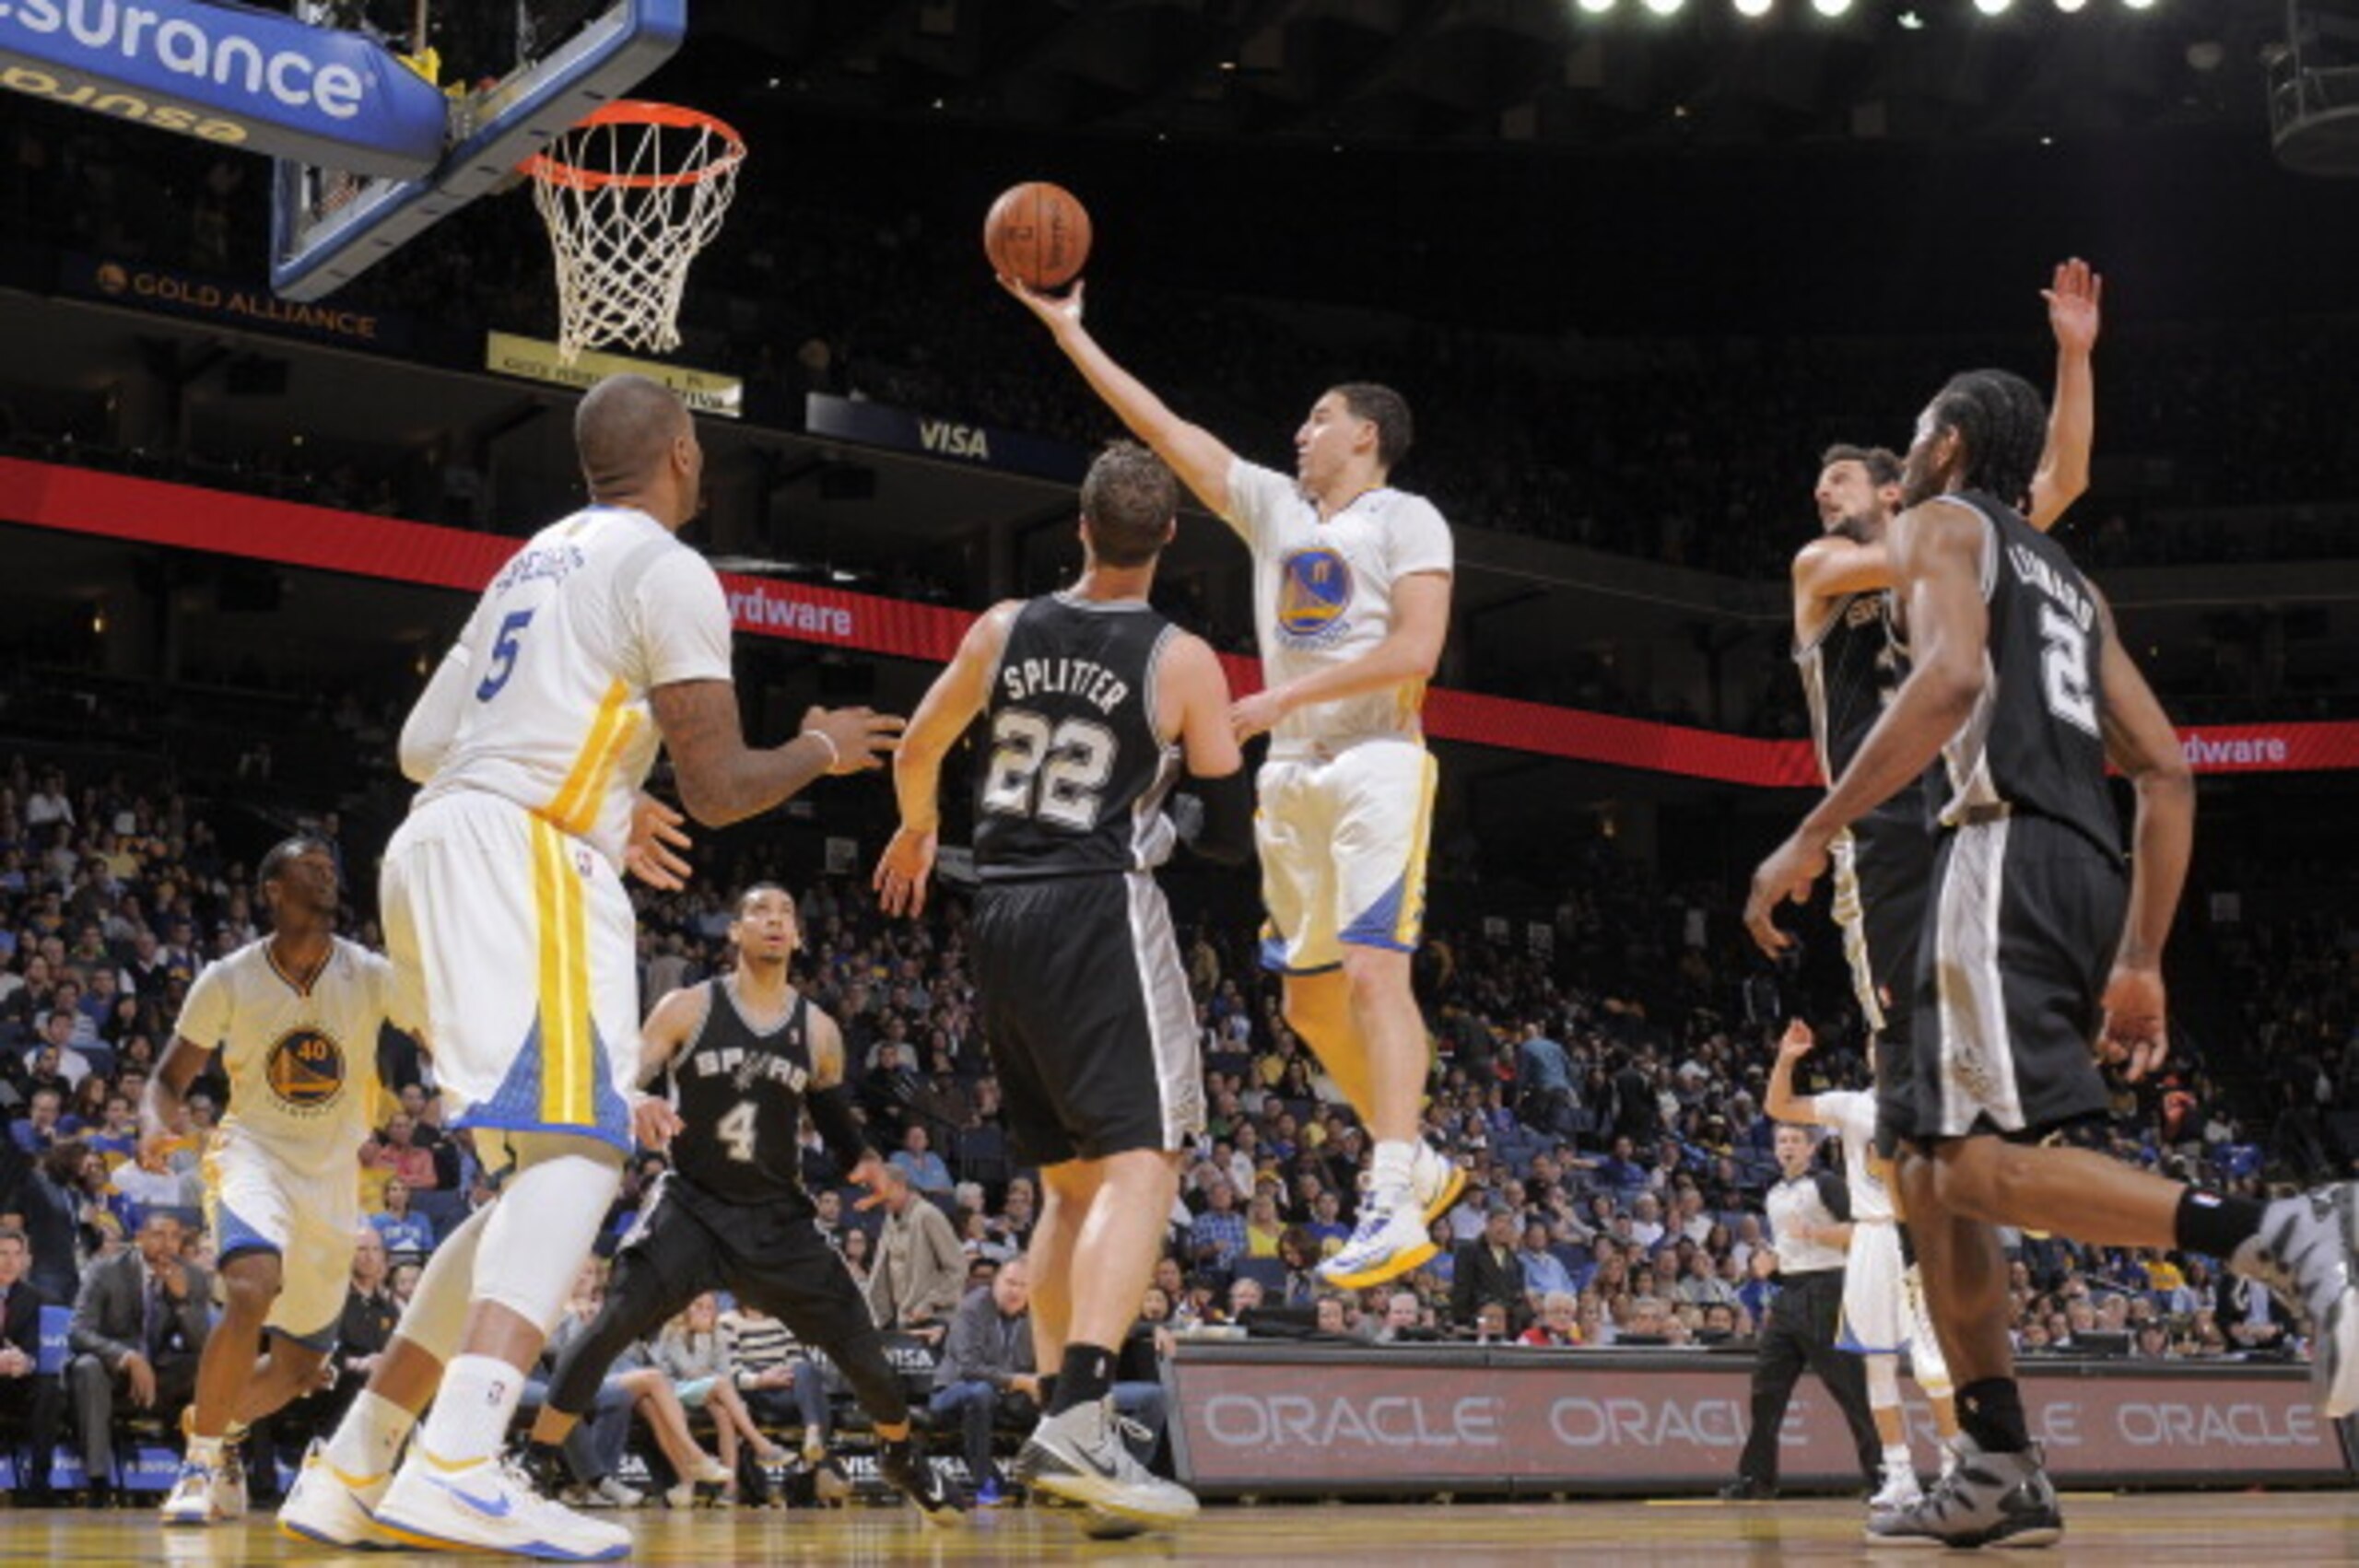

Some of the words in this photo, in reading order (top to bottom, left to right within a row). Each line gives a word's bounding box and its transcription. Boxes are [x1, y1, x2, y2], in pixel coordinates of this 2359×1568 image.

[0, 0, 363, 119] surance
[135, 274, 220, 308] GOLD
[226, 292, 378, 338] ALLIANCE
[918, 419, 991, 460] VISA
[475, 607, 537, 704] 5
[2039, 603, 2104, 739] 2
[1003, 658, 1130, 716] SPLITTER
[980, 706, 1121, 833] 22
[297, 1039, 328, 1061] 40
[716, 1099, 760, 1163] 4
[882, 1345, 934, 1367] VISA
[1205, 1394, 1500, 1446] ORACLE
[2117, 1401, 2321, 1447] ORACLE
[839, 1457, 876, 1474] VIS
